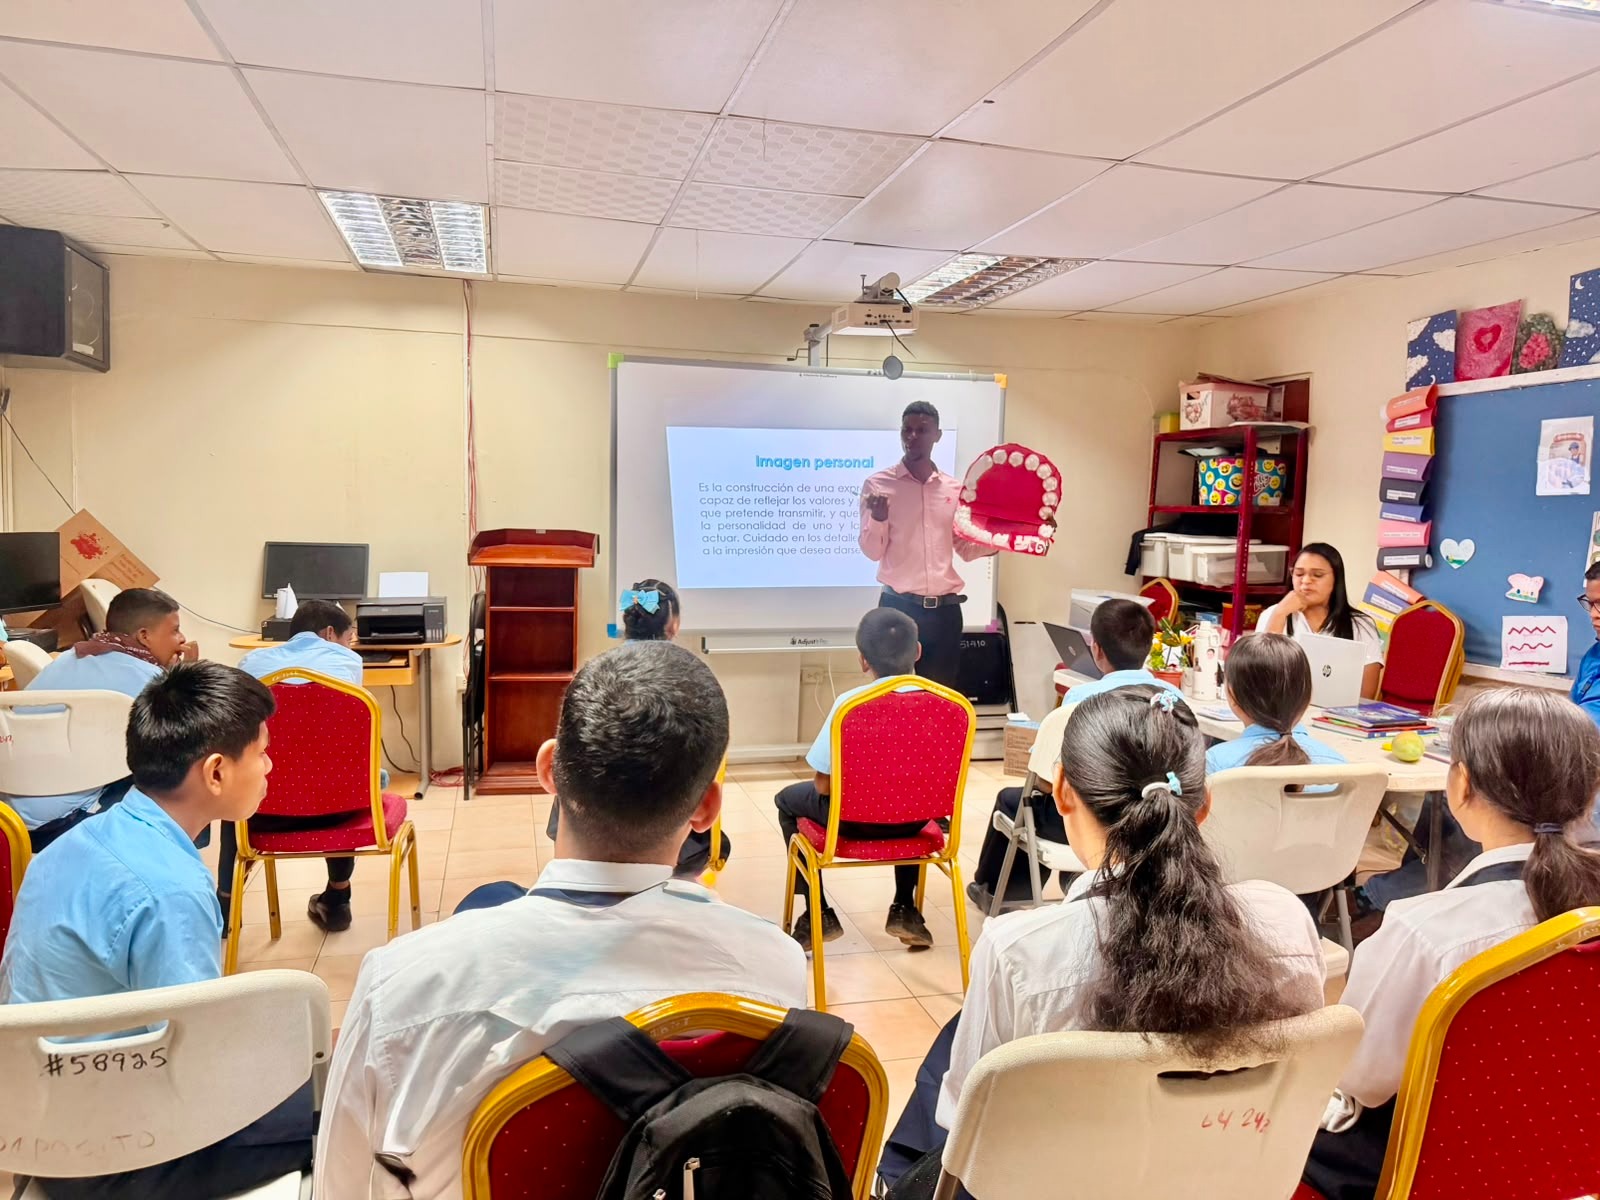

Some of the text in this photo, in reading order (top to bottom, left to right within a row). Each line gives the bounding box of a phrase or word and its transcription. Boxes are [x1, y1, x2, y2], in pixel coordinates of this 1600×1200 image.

[755, 455, 875, 471] Imagen personal
[698, 482, 861, 497] Es la construcción de una expr
[699, 495, 854, 508] capaz de reflejar los valores y
[700, 508, 859, 520] que pretende transmitir, y que
[700, 521, 711, 531] la
[717, 520, 786, 532] personalidad
[792, 521, 807, 531] de
[812, 522, 833, 531] uno
[839, 523, 846, 532] y
[701, 533, 858, 543] actuar. Cuidado en los detalle
[702, 545, 861, 557] a la impresión que desea darse
[40, 1047, 168, 1077] #58925
